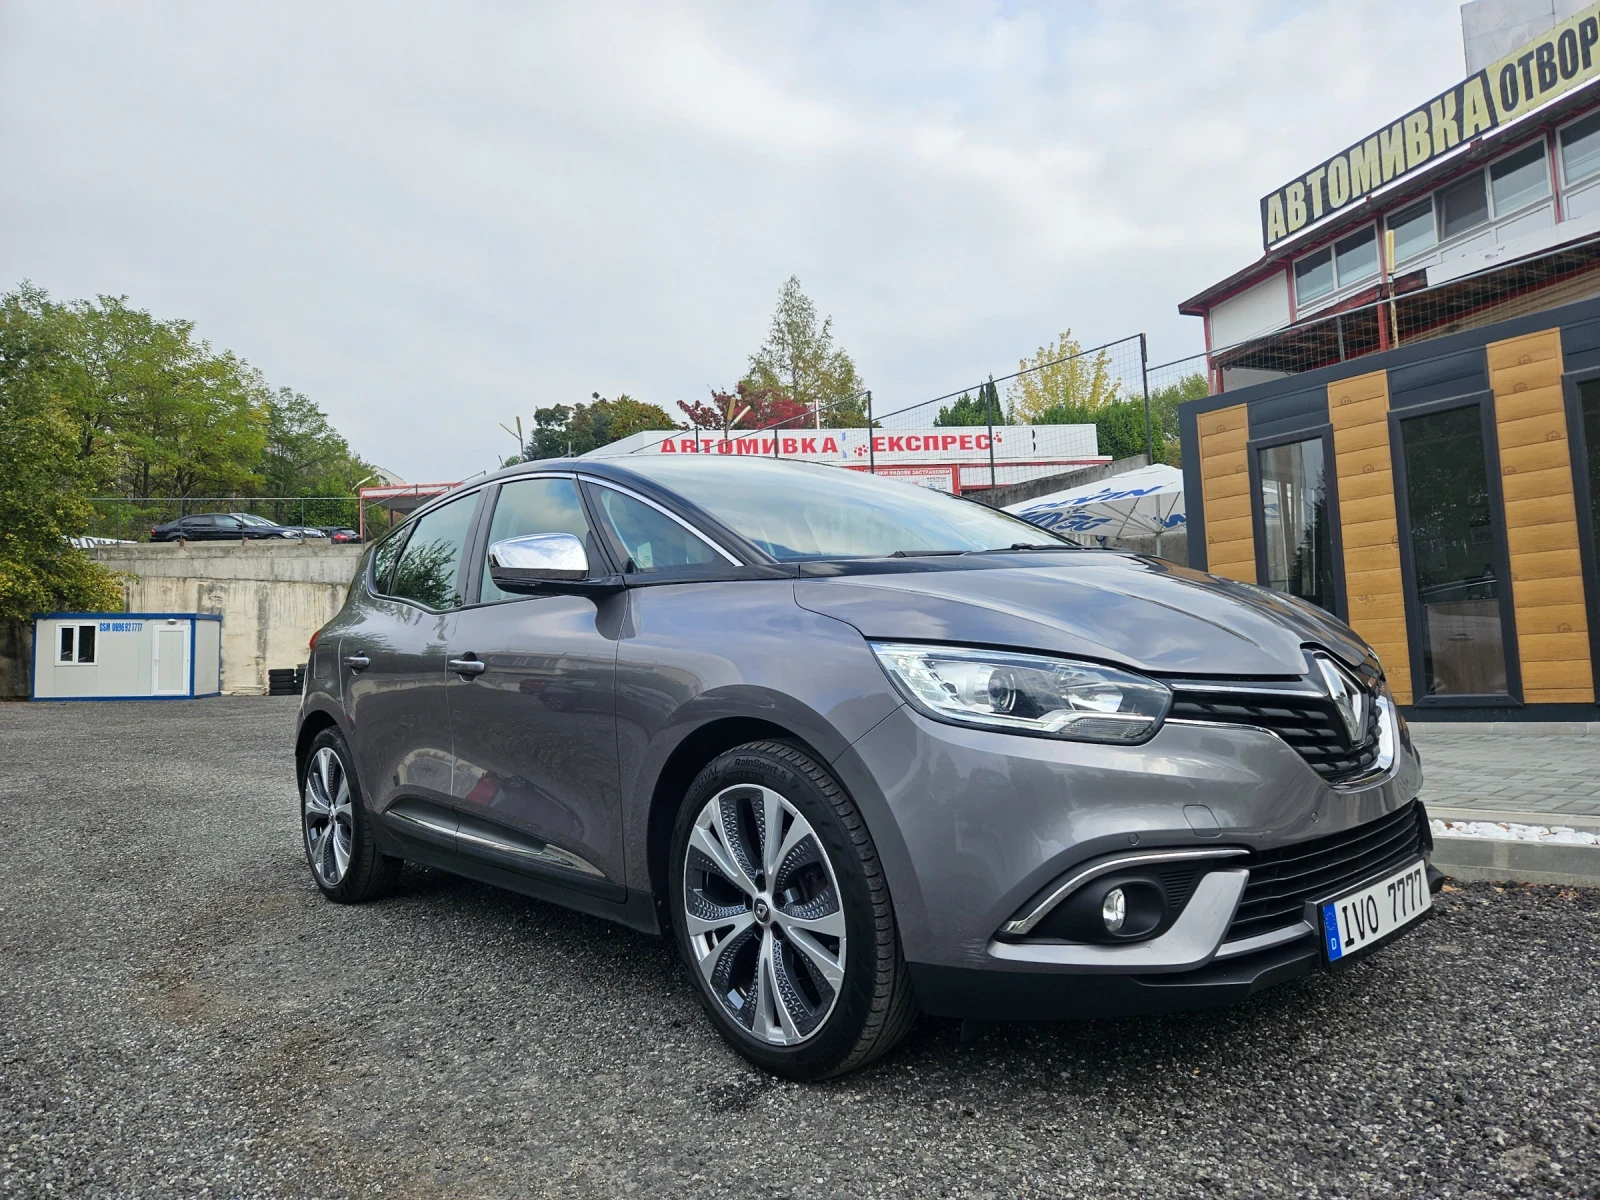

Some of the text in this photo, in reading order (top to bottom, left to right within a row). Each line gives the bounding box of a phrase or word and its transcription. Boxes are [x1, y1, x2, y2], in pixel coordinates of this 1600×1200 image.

[1267, 12, 1600, 245] АВТОМИВКА ОТВОР
[661, 434, 991, 455] АВТОМИВКА ЕКСПРЕС
[100, 622, 110, 632] GSM
[735, 758, 778, 775] RainSport
[780, 770, 788, 780] 5
[1342, 868, 1422, 948] IVO 7777
[1331, 938, 1337, 950] D
